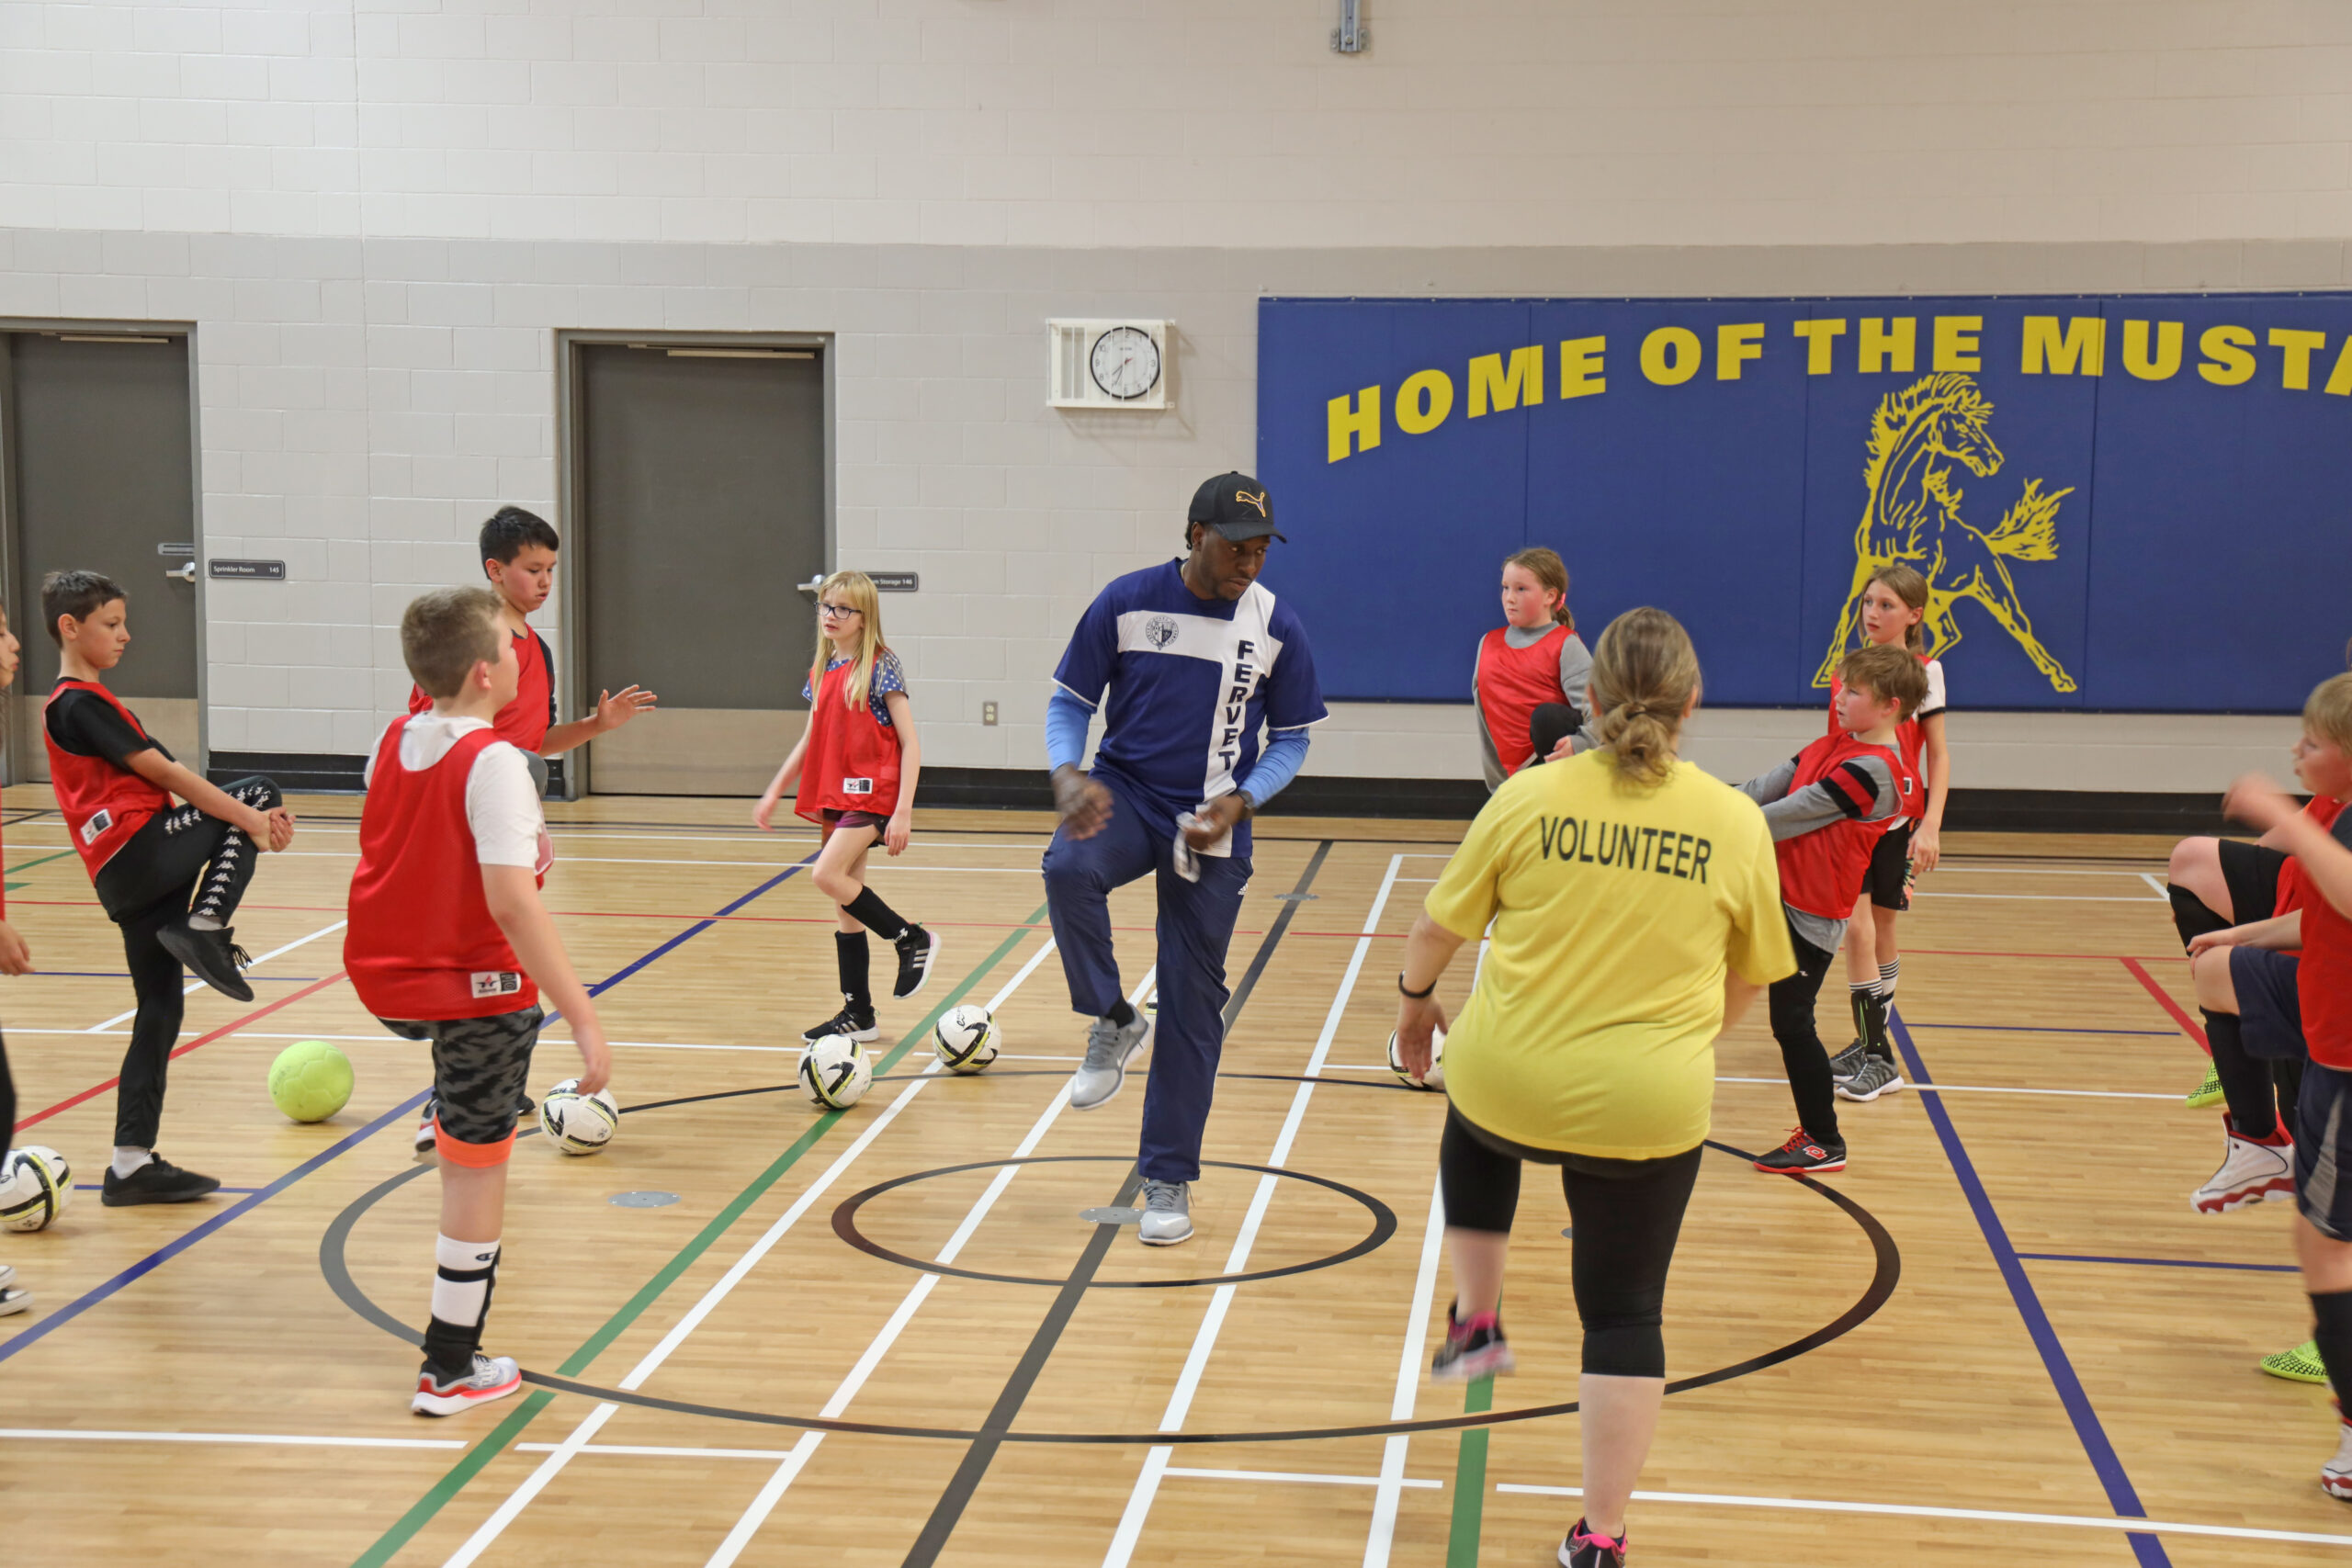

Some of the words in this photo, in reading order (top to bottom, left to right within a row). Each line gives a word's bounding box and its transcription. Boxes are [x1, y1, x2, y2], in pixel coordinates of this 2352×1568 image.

[1328, 335, 1606, 464] HOME
[1639, 322, 1765, 386] OF
[1793, 315, 1984, 376] THE
[1218, 639, 1255, 772] FERVET
[1540, 816, 1713, 885] VOLUNTEER
